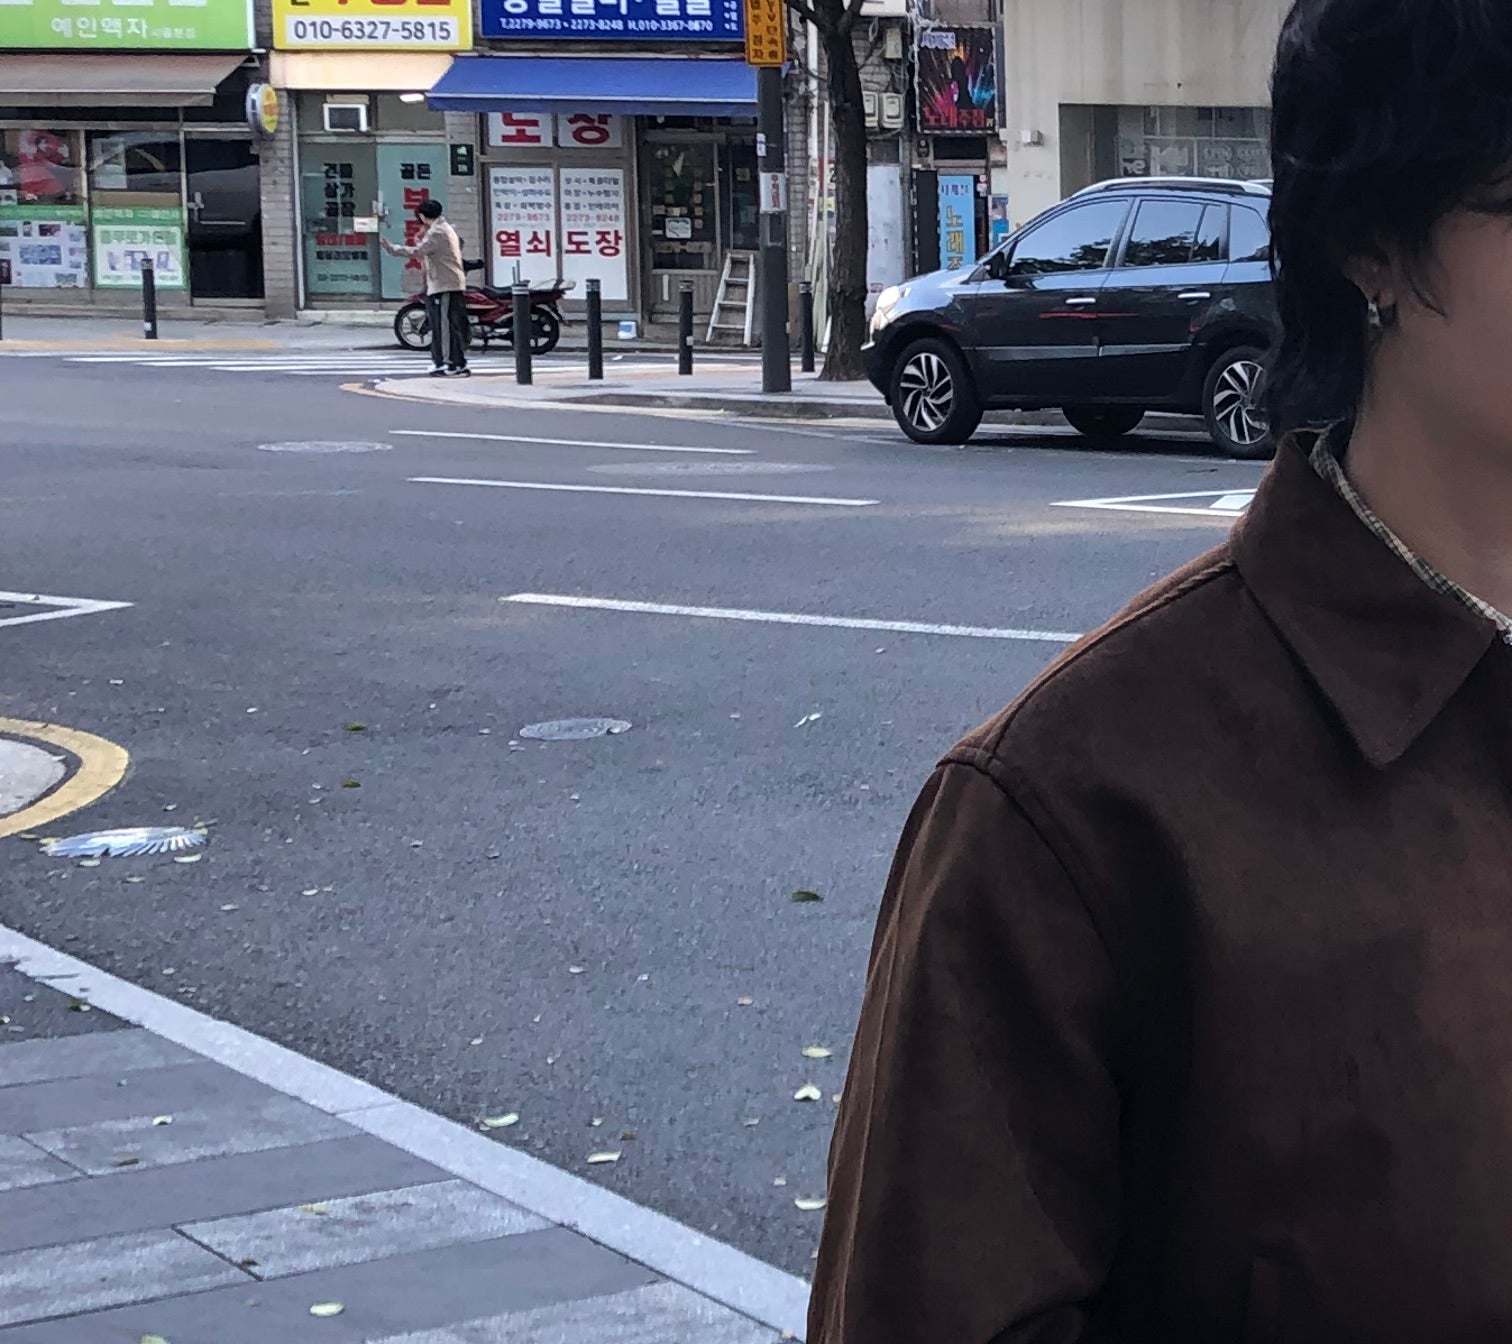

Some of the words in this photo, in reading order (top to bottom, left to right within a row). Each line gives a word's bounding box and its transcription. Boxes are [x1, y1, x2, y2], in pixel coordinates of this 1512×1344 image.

[51, 17, 147, 38] 예인액자
[294, 20, 451, 40] 010-6327-5815
[495, 230, 552, 257] 열쇠
[564, 230, 623, 257] 도장
